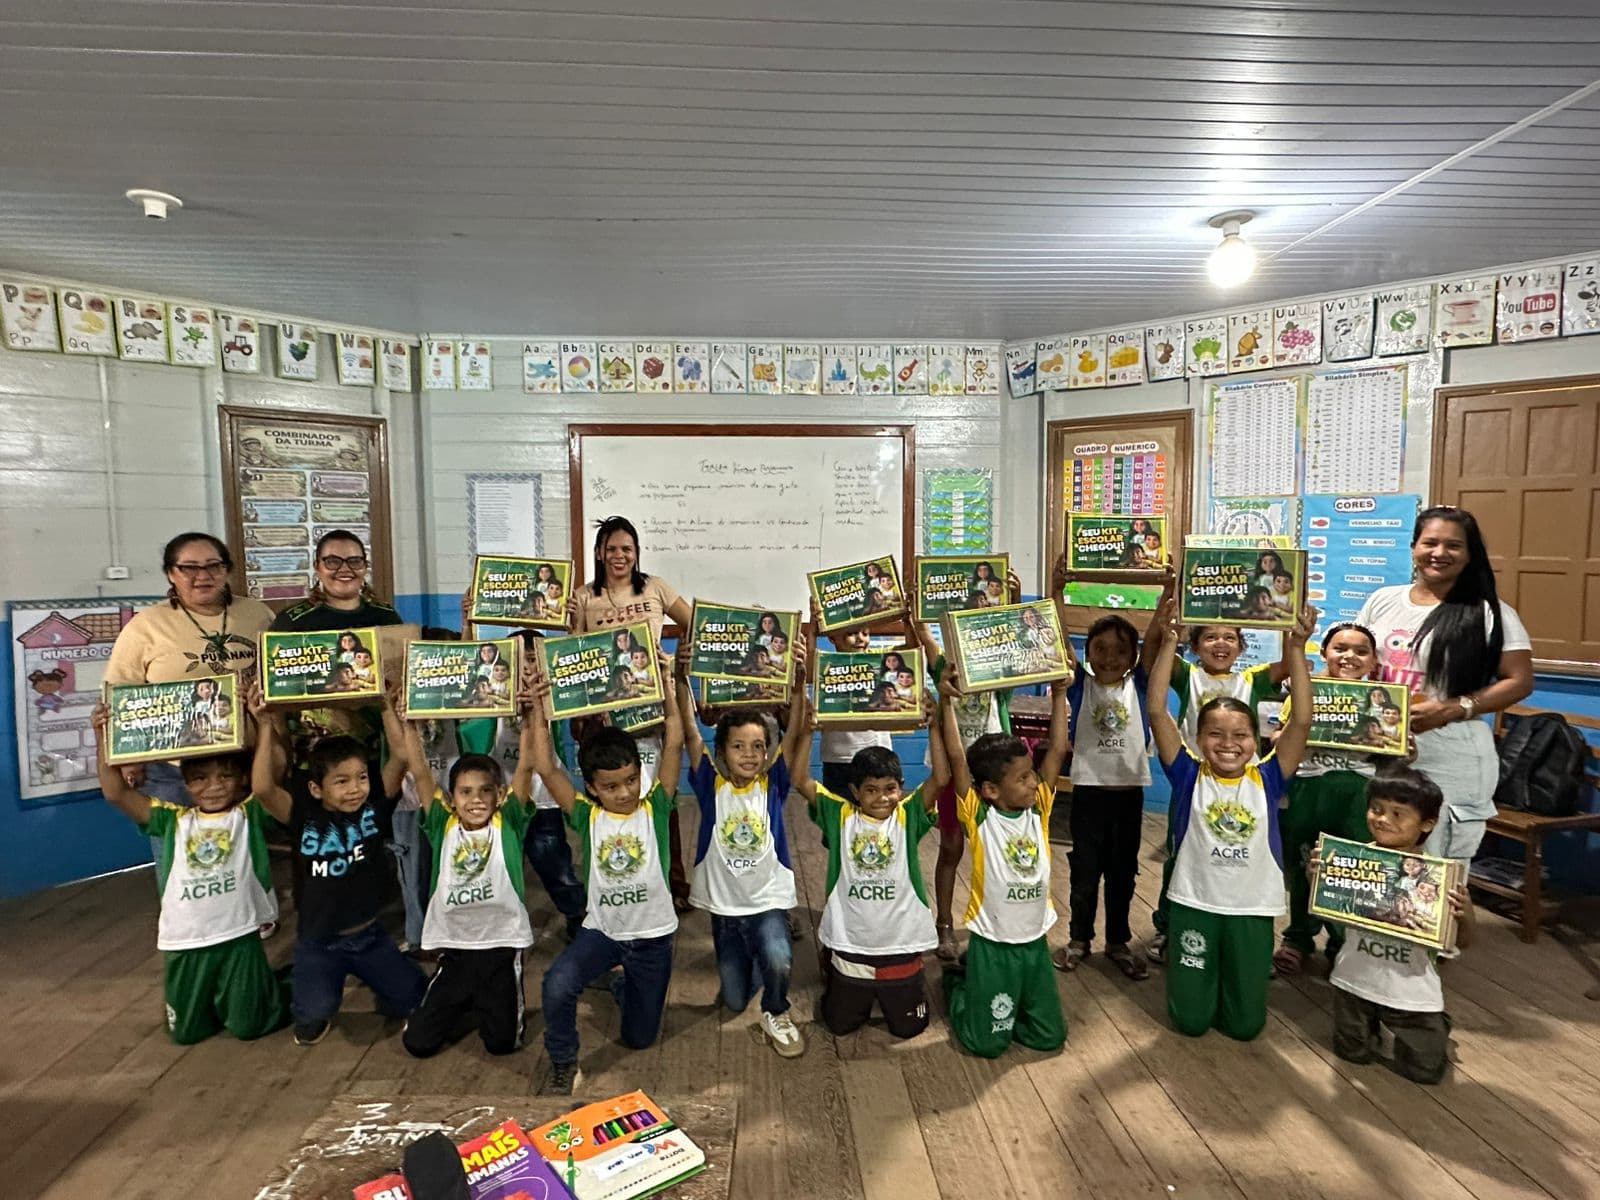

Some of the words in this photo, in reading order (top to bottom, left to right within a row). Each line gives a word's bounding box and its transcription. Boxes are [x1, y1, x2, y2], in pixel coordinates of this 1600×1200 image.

[264, 430, 341, 441] COMBINADOS
[1337, 501, 1373, 509] CORES
[1078, 535, 1123, 544] ESCOLAR
[1078, 542, 1125, 552] CHEGOU!
[1197, 566, 1219, 575] SEU
[1221, 565, 1241, 574] KIT
[825, 584, 841, 592] SEU
[842, 578, 856, 587] KIT
[927, 582, 967, 591] ESCOLAR
[1192, 575, 1247, 586] ESCOLAR
[824, 584, 862, 600] ESCOLAR
[927, 590, 969, 600] CHEGOU!
[1191, 584, 1248, 595] CHEGOU!
[827, 590, 865, 608] CHEGOU!
[705, 624, 725, 632] SEU
[727, 624, 744, 632] KIT
[971, 628, 990, 639] SEU
[991, 624, 1009, 635] KIT
[701, 633, 749, 641] ESCOLAR
[279, 648, 302, 658] SEU
[304, 646, 322, 656] KIT
[700, 643, 749, 651] CHEGOU!
[275, 654, 330, 667] ESCOLAR
[444, 656, 463, 666] KIT
[558, 652, 580, 667] SEU
[581, 648, 600, 660] KIT
[275, 662, 331, 676] CHEGOU!
[417, 666, 468, 677] ESCOLAR
[555, 657, 607, 677] ESCOLAR
[830, 666, 849, 675] SEU
[851, 665, 868, 673] KIT
[416, 674, 469, 688] CHEGOU!
[557, 666, 610, 688] CHEGOU!
[825, 673, 874, 684] ESCOLAR
[825, 681, 876, 693] CHEGOU!
[1312, 696, 1332, 704] SEU
[1334, 696, 1353, 704] KIT
[1312, 714, 1359, 722] HEGOU!
[1098, 739, 1125, 747] ACRE
[1211, 847, 1249, 858] ACRE
[312, 844, 365, 877] MOE
[1333, 855, 1357, 868] SEU
[1358, 860, 1381, 871] KIT
[1327, 867, 1386, 882] ESCOLAR
[181, 877, 236, 900] ACRE
[1325, 877, 1386, 893] CHEGOU!
[446, 883, 494, 905] ACRE
[599, 889, 648, 906] ACRE
[848, 886, 895, 900] ACRE
[1008, 888, 1042, 900] ACRE
[1358, 939, 1411, 964] ACRE
[467, 1147, 529, 1185] UMANAS
